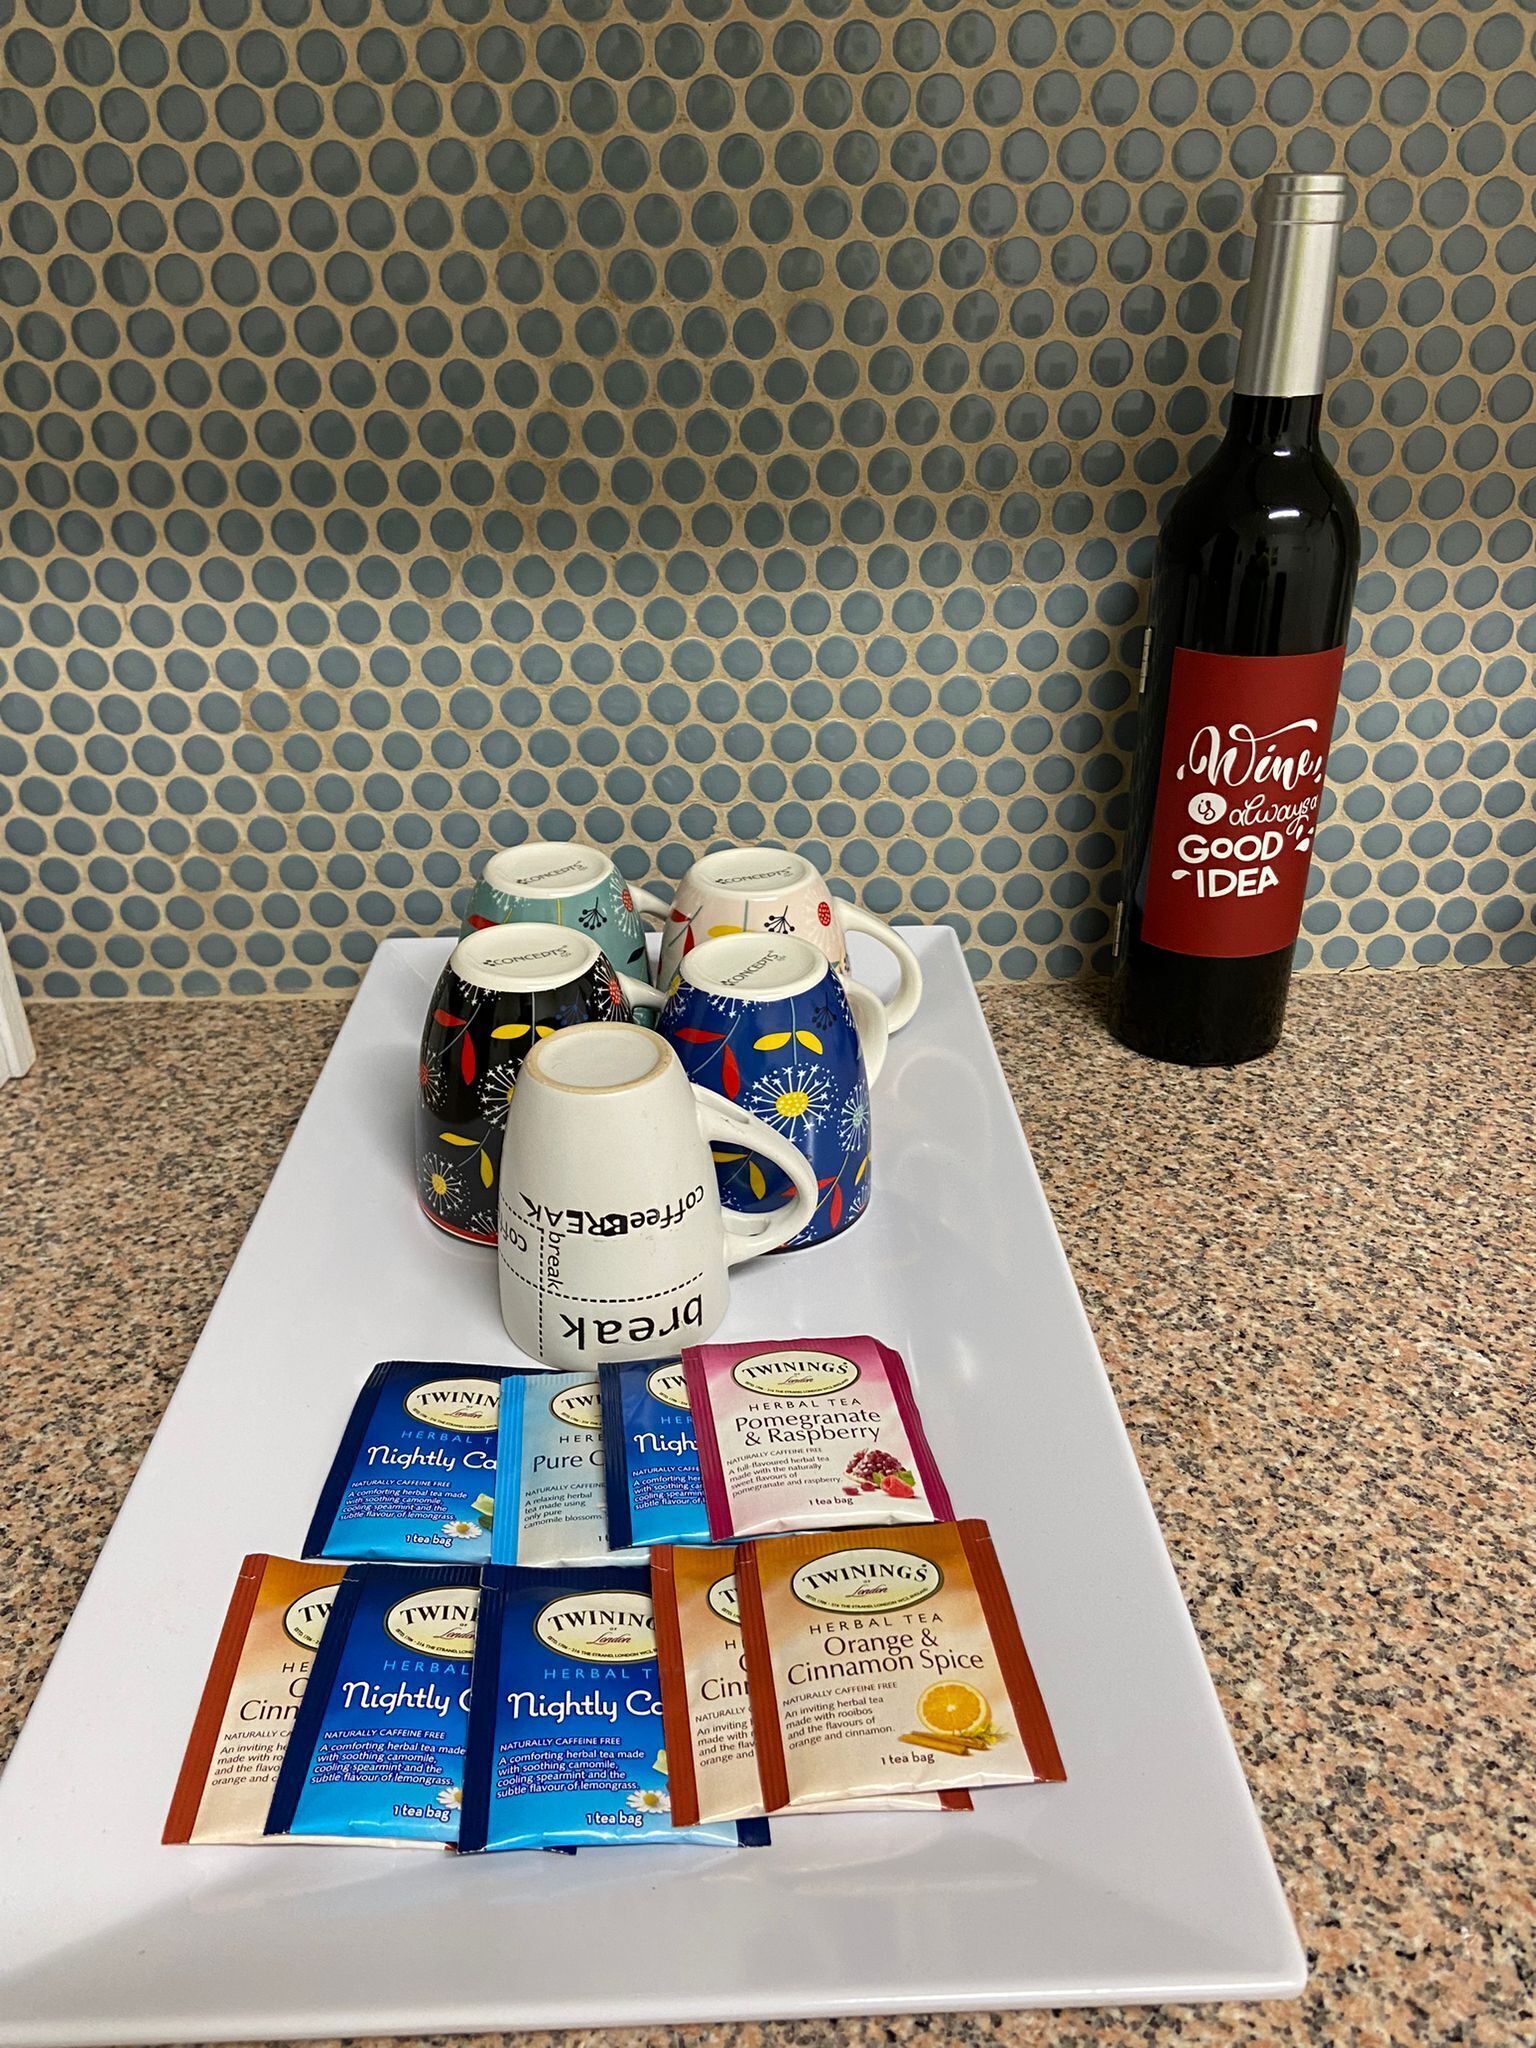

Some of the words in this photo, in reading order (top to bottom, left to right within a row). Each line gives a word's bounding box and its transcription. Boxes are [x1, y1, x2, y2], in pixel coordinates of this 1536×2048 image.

[1190, 719, 1318, 790] Wine
[1198, 799, 1215, 820] is
[1229, 794, 1309, 836] always
[1178, 832, 1283, 863] GOOD
[1197, 866, 1280, 898] IDEA
[494, 946, 566, 966] CONCEPTS
[547, 1231, 566, 1290] break
[560, 1294, 703, 1350] break
[742, 1362, 849, 1378] TWININGS
[417, 1391, 499, 1408] TWININ
[749, 1400, 819, 1411] HERBAL
[735, 1410, 881, 1432] Pomegranate
[402, 1430, 472, 1443] HERBAL
[634, 1433, 698, 1456] Nigh
[745, 1432, 761, 1446] &
[768, 1427, 880, 1445] Raspberry
[368, 1446, 455, 1471] Nightly
[534, 1455, 582, 1472] Pure
[726, 1452, 768, 1466] NATURALLY
[791, 1456, 815, 1464] herbal
[633, 1466, 675, 1476] NATURALLY
[729, 1473, 751, 1482] made
[753, 1467, 771, 1476] with
[773, 1465, 786, 1473] the
[788, 1463, 822, 1473] naturally
[526, 1483, 568, 1496] NATURALLY
[731, 1480, 753, 1490] sweet
[756, 1474, 787, 1484] flavours
[732, 1481, 784, 1498] pomegranate
[533, 1494, 565, 1505] relaxing
[539, 1503, 562, 1511] made
[834, 1497, 854, 1506] bag
[524, 1513, 541, 1522] only
[543, 1510, 562, 1519] pure
[524, 1516, 562, 1529] camomile
[413, 1535, 430, 1543] tea
[433, 1536, 452, 1547] bag
[802, 1563, 928, 1590] TWININGS
[845, 1584, 887, 1597] London
[810, 1617, 893, 1635] HERBAL
[904, 1613, 943, 1624] TEA
[586, 1633, 631, 1644] London
[824, 1632, 914, 1657] Orange
[921, 1628, 939, 1646] &
[384, 1660, 469, 1675] HERBAL
[544, 1669, 629, 1679] HERBAL
[788, 1653, 913, 1685] Cinnamon
[922, 1649, 984, 1675] Spice
[343, 1681, 450, 1718] Nightly
[782, 1690, 832, 1707] NATURALLY
[835, 1684, 875, 1696] CAFFEINE
[239, 1699, 299, 1721] Cinn
[508, 1690, 617, 1723] Nightly
[785, 1711, 798, 1719] An
[800, 1702, 834, 1716] inviting
[837, 1698, 866, 1708] herbal
[695, 1708, 745, 1723] NATURALLY
[786, 1719, 812, 1730] made
[814, 1712, 835, 1723] with
[838, 1708, 873, 1719] rooibos
[224, 1731, 277, 1741] NATURALLY
[325, 1729, 377, 1739] NATURALLY
[380, 1729, 422, 1738] CAFFEINE
[425, 1731, 445, 1739] FREE
[787, 1729, 805, 1740] and
[808, 1724, 823, 1733] the
[826, 1719, 863, 1730] flavours
[865, 1716, 876, 1724] of
[330, 1742, 384, 1751] comforting
[387, 1742, 418, 1751] herbal
[420, 1744, 436, 1752] tea
[438, 1745, 466, 1755] made
[500, 1739, 553, 1751] NATURALLY
[789, 1736, 822, 1750] orange
[824, 1732, 842, 1740] and
[317, 1754, 339, 1763] with
[342, 1752, 384, 1762] soothing
[498, 1757, 506, 1765] A
[509, 1751, 563, 1763] comforting
[566, 1750, 597, 1758] herbal
[617, 1750, 644, 1758] made
[889, 1754, 909, 1764] tea
[912, 1751, 935, 1764] bag
[314, 1763, 350, 1774] cooling
[353, 1763, 401, 1773] spearmint
[404, 1764, 423, 1772] and
[426, 1764, 442, 1774] the
[498, 1766, 520, 1776] with
[523, 1761, 565, 1771] soothing
[311, 1774, 340, 1784] subtle
[344, 1773, 378, 1782] flavour
[381, 1773, 393, 1782] of
[497, 1776, 533, 1787] cooling
[537, 1770, 585, 1781] spearmint
[588, 1770, 606, 1778] and
[610, 1770, 625, 1778] the
[496, 1786, 526, 1799] subtle
[530, 1783, 565, 1792] flavour
[568, 1782, 579, 1790] of
[402, 1805, 423, 1817] tea
[426, 1805, 450, 1822] bag
[594, 1813, 615, 1824] tea
[618, 1812, 643, 1826] bag
